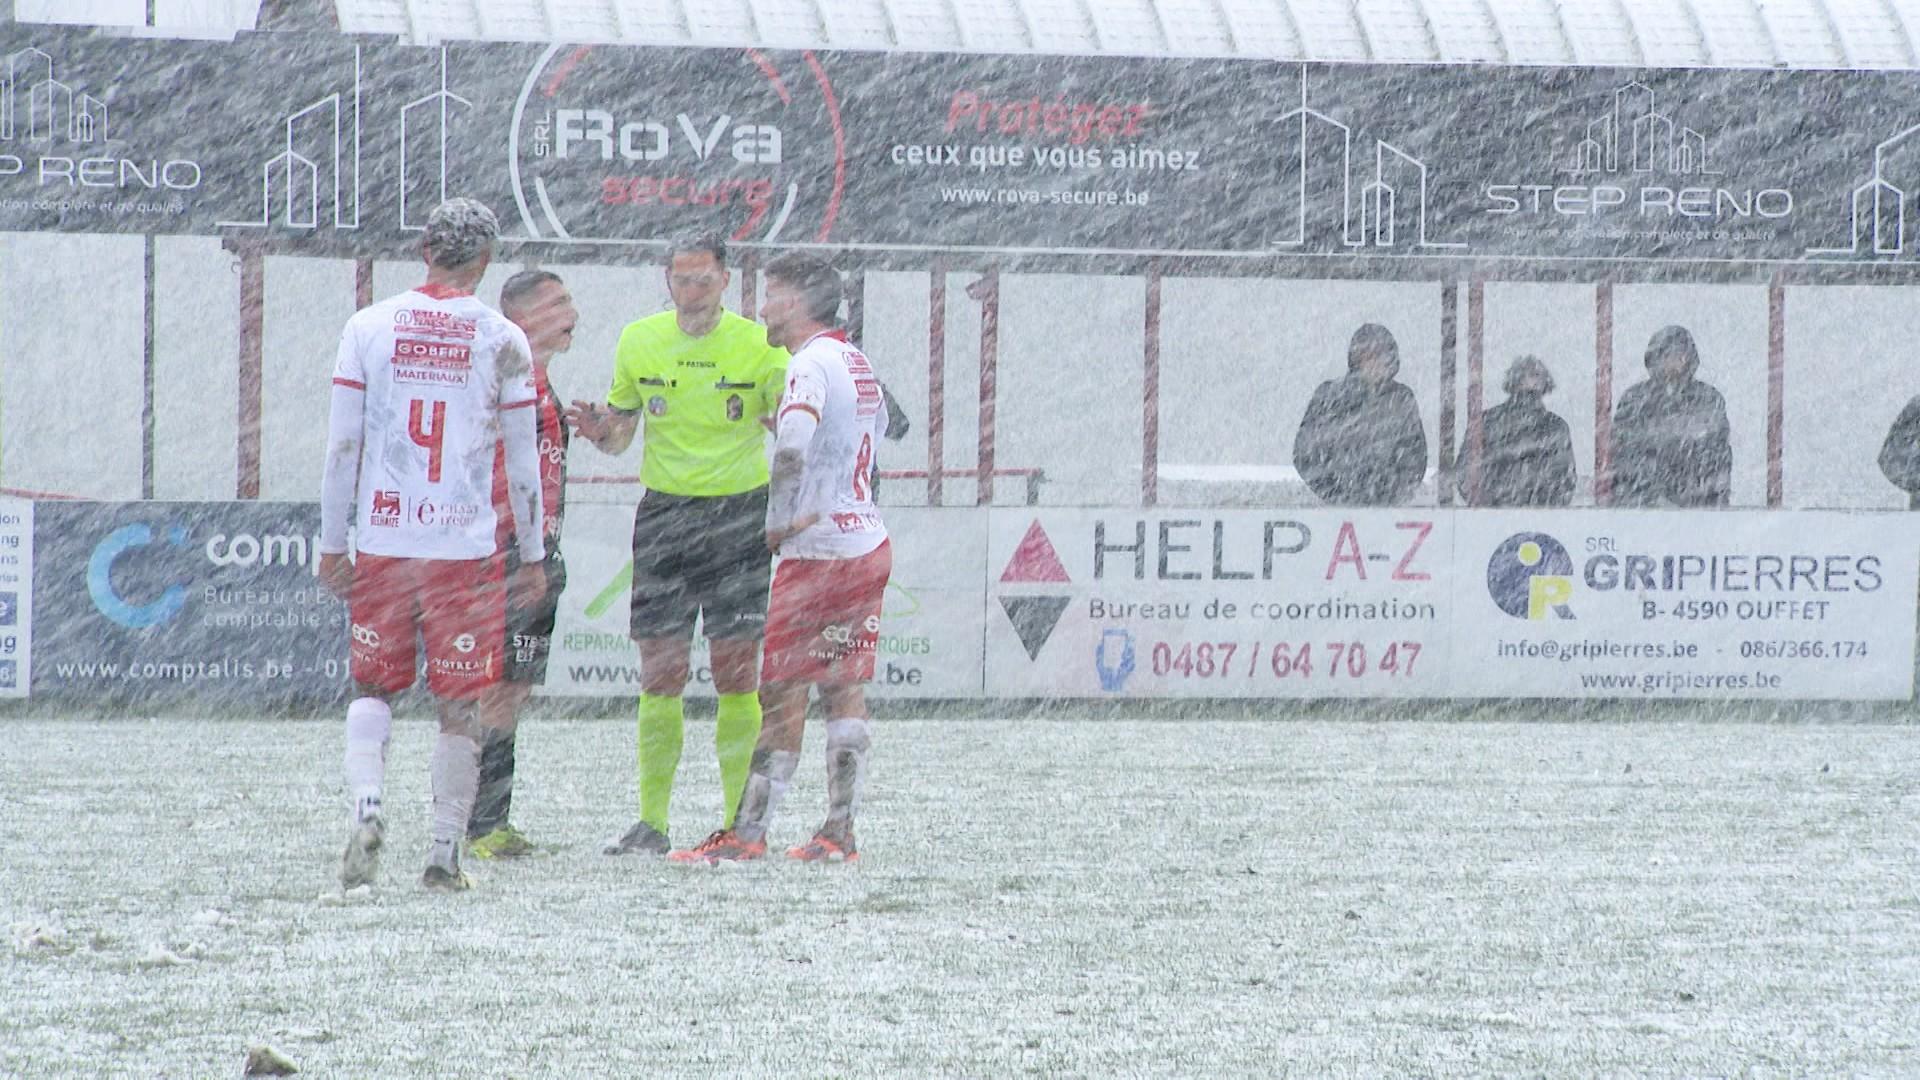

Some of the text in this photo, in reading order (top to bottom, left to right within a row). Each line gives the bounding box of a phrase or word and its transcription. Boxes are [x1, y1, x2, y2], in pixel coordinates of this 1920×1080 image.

[944, 88, 1149, 144] Protégez
[534, 111, 551, 157] SRL
[891, 144, 1200, 172] ceux que vous aimez
[39, 156, 201, 190] RENO
[601, 175, 773, 206] secure
[941, 186, 1149, 207] www.rova-secure.be
[1486, 185, 1793, 218] STEP RENO
[408, 399, 446, 483] 4
[1093, 520, 1434, 581] HELP A-Z
[1585, 536, 1620, 552] SRL
[1583, 554, 1883, 593] GRIPIERRES
[205, 585, 284, 605] Bureau
[204, 608, 320, 630] comptable
[1089, 598, 1436, 622] Bureau de coordination
[1673, 602, 1728, 620] 4590
[1736, 602, 1829, 620] OUFFET
[1152, 641, 1237, 678] 0487
[1271, 642, 1313, 678] 64
[1327, 642, 1366, 678] 70
[1379, 642, 1422, 678] 47
[1498, 638, 1699, 662] info@gripierres.be
[1740, 639, 1868, 660] 086/366.174
[57, 655, 293, 680] www.comptalis.be
[1581, 671, 1782, 694] www.gripierres.be
